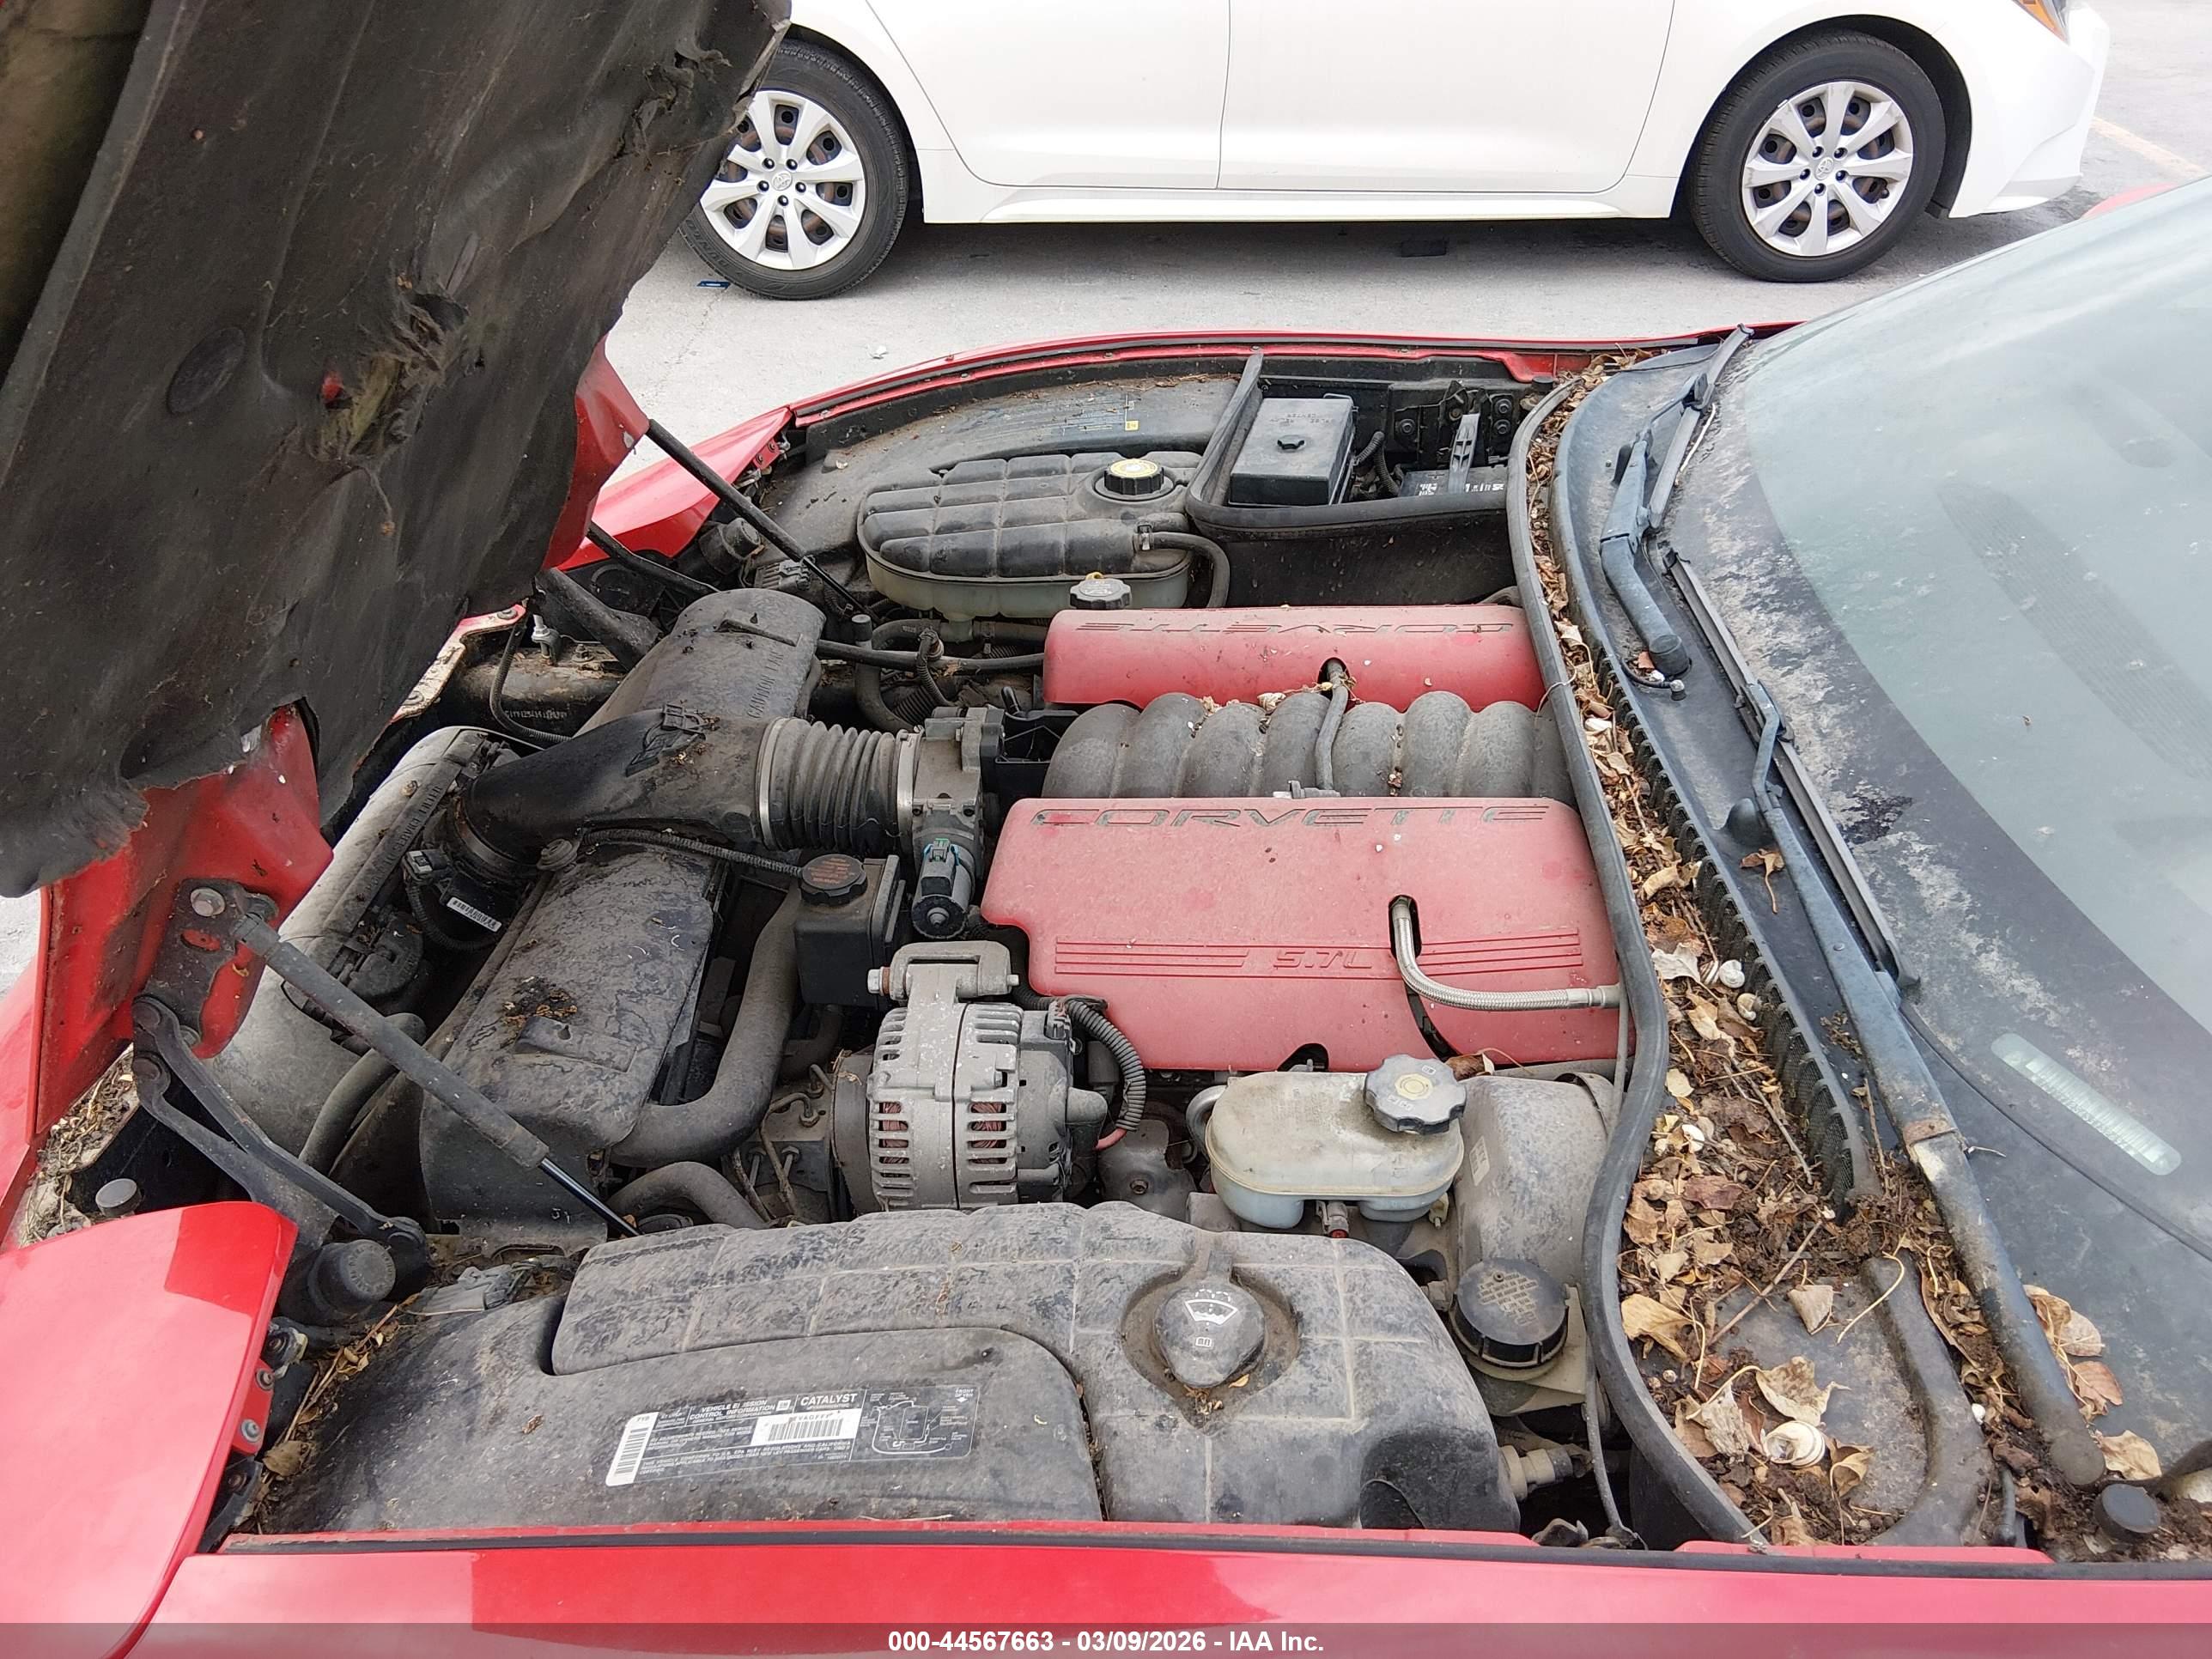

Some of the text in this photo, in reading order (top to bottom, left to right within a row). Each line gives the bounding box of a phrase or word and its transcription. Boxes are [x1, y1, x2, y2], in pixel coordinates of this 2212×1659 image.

[685, 218, 729, 268] DUNLO
[1076, 623, 1514, 633] CORVETTE
[1030, 805, 1550, 827] CORVETTE
[1273, 950, 1372, 969] 5.7L
[800, 1393, 858, 1406] CATALYST
[690, 1411, 723, 1420] CONTROL
[726, 1405, 776, 1416] INFORMATION
[702, 1404, 732, 1413] VEHICLE
